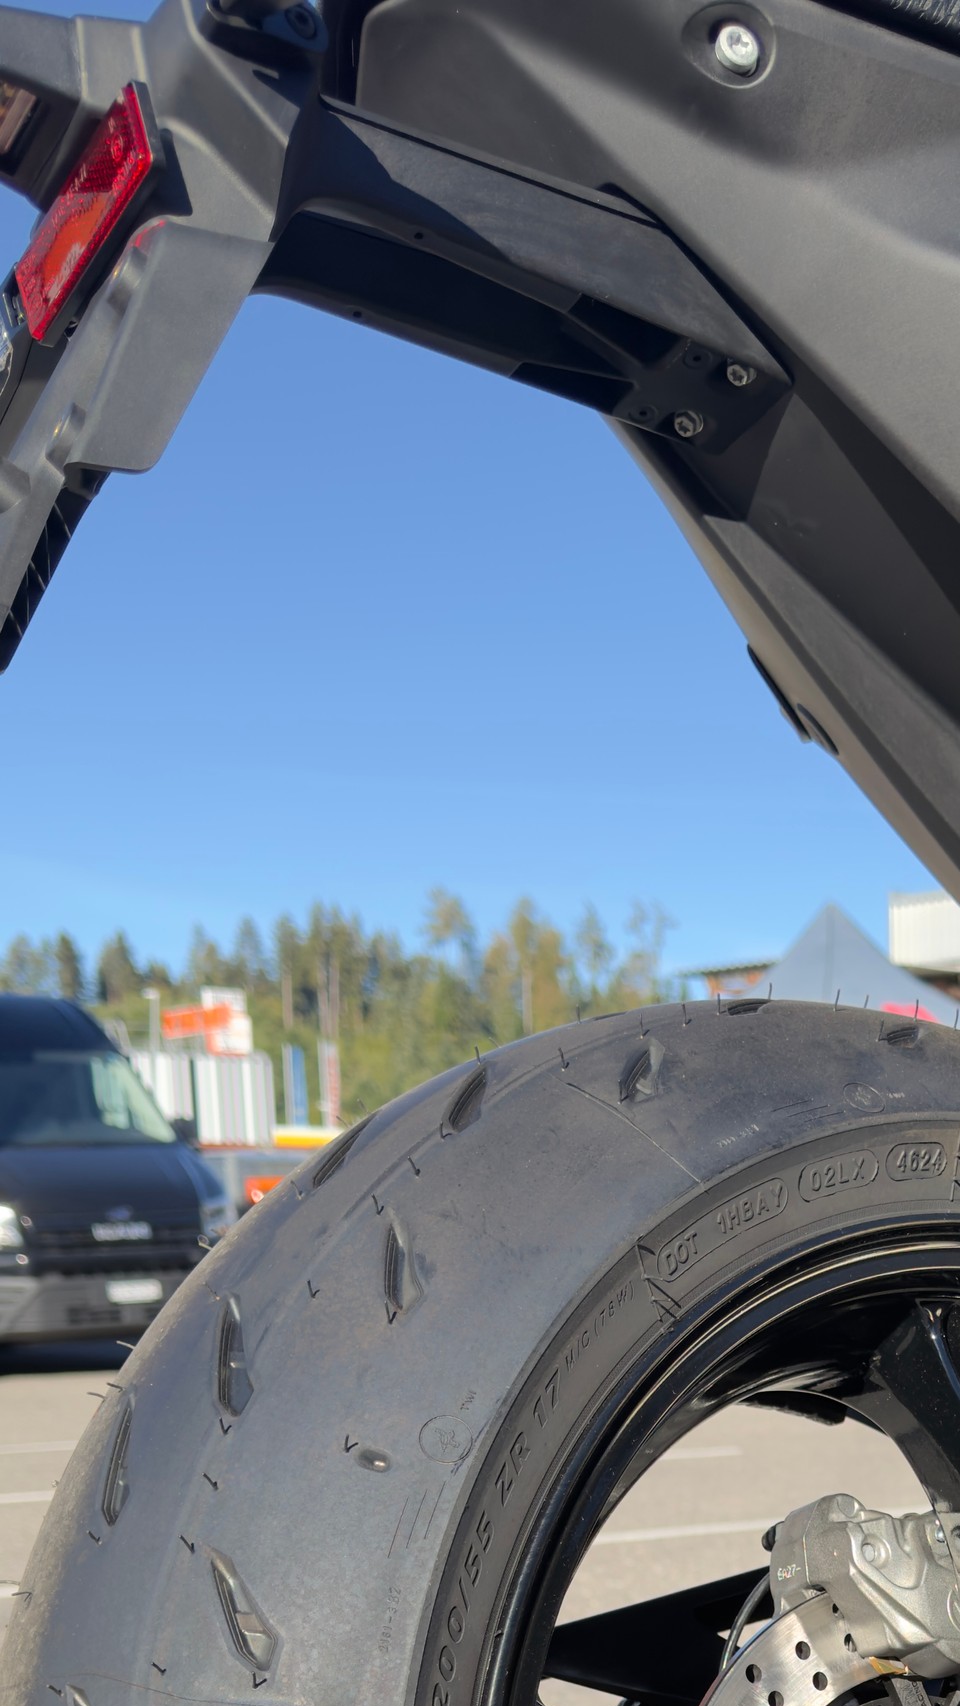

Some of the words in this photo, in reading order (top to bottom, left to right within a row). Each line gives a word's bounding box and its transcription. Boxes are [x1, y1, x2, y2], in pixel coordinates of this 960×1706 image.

[662, 1232, 699, 1277] DOT
[811, 1156, 866, 1192] 02LX
[896, 1150, 943, 1173] 4624
[494, 1430, 532, 1503] ZR
[533, 1369, 563, 1428] 17
[565, 1330, 592, 1371] M/C
